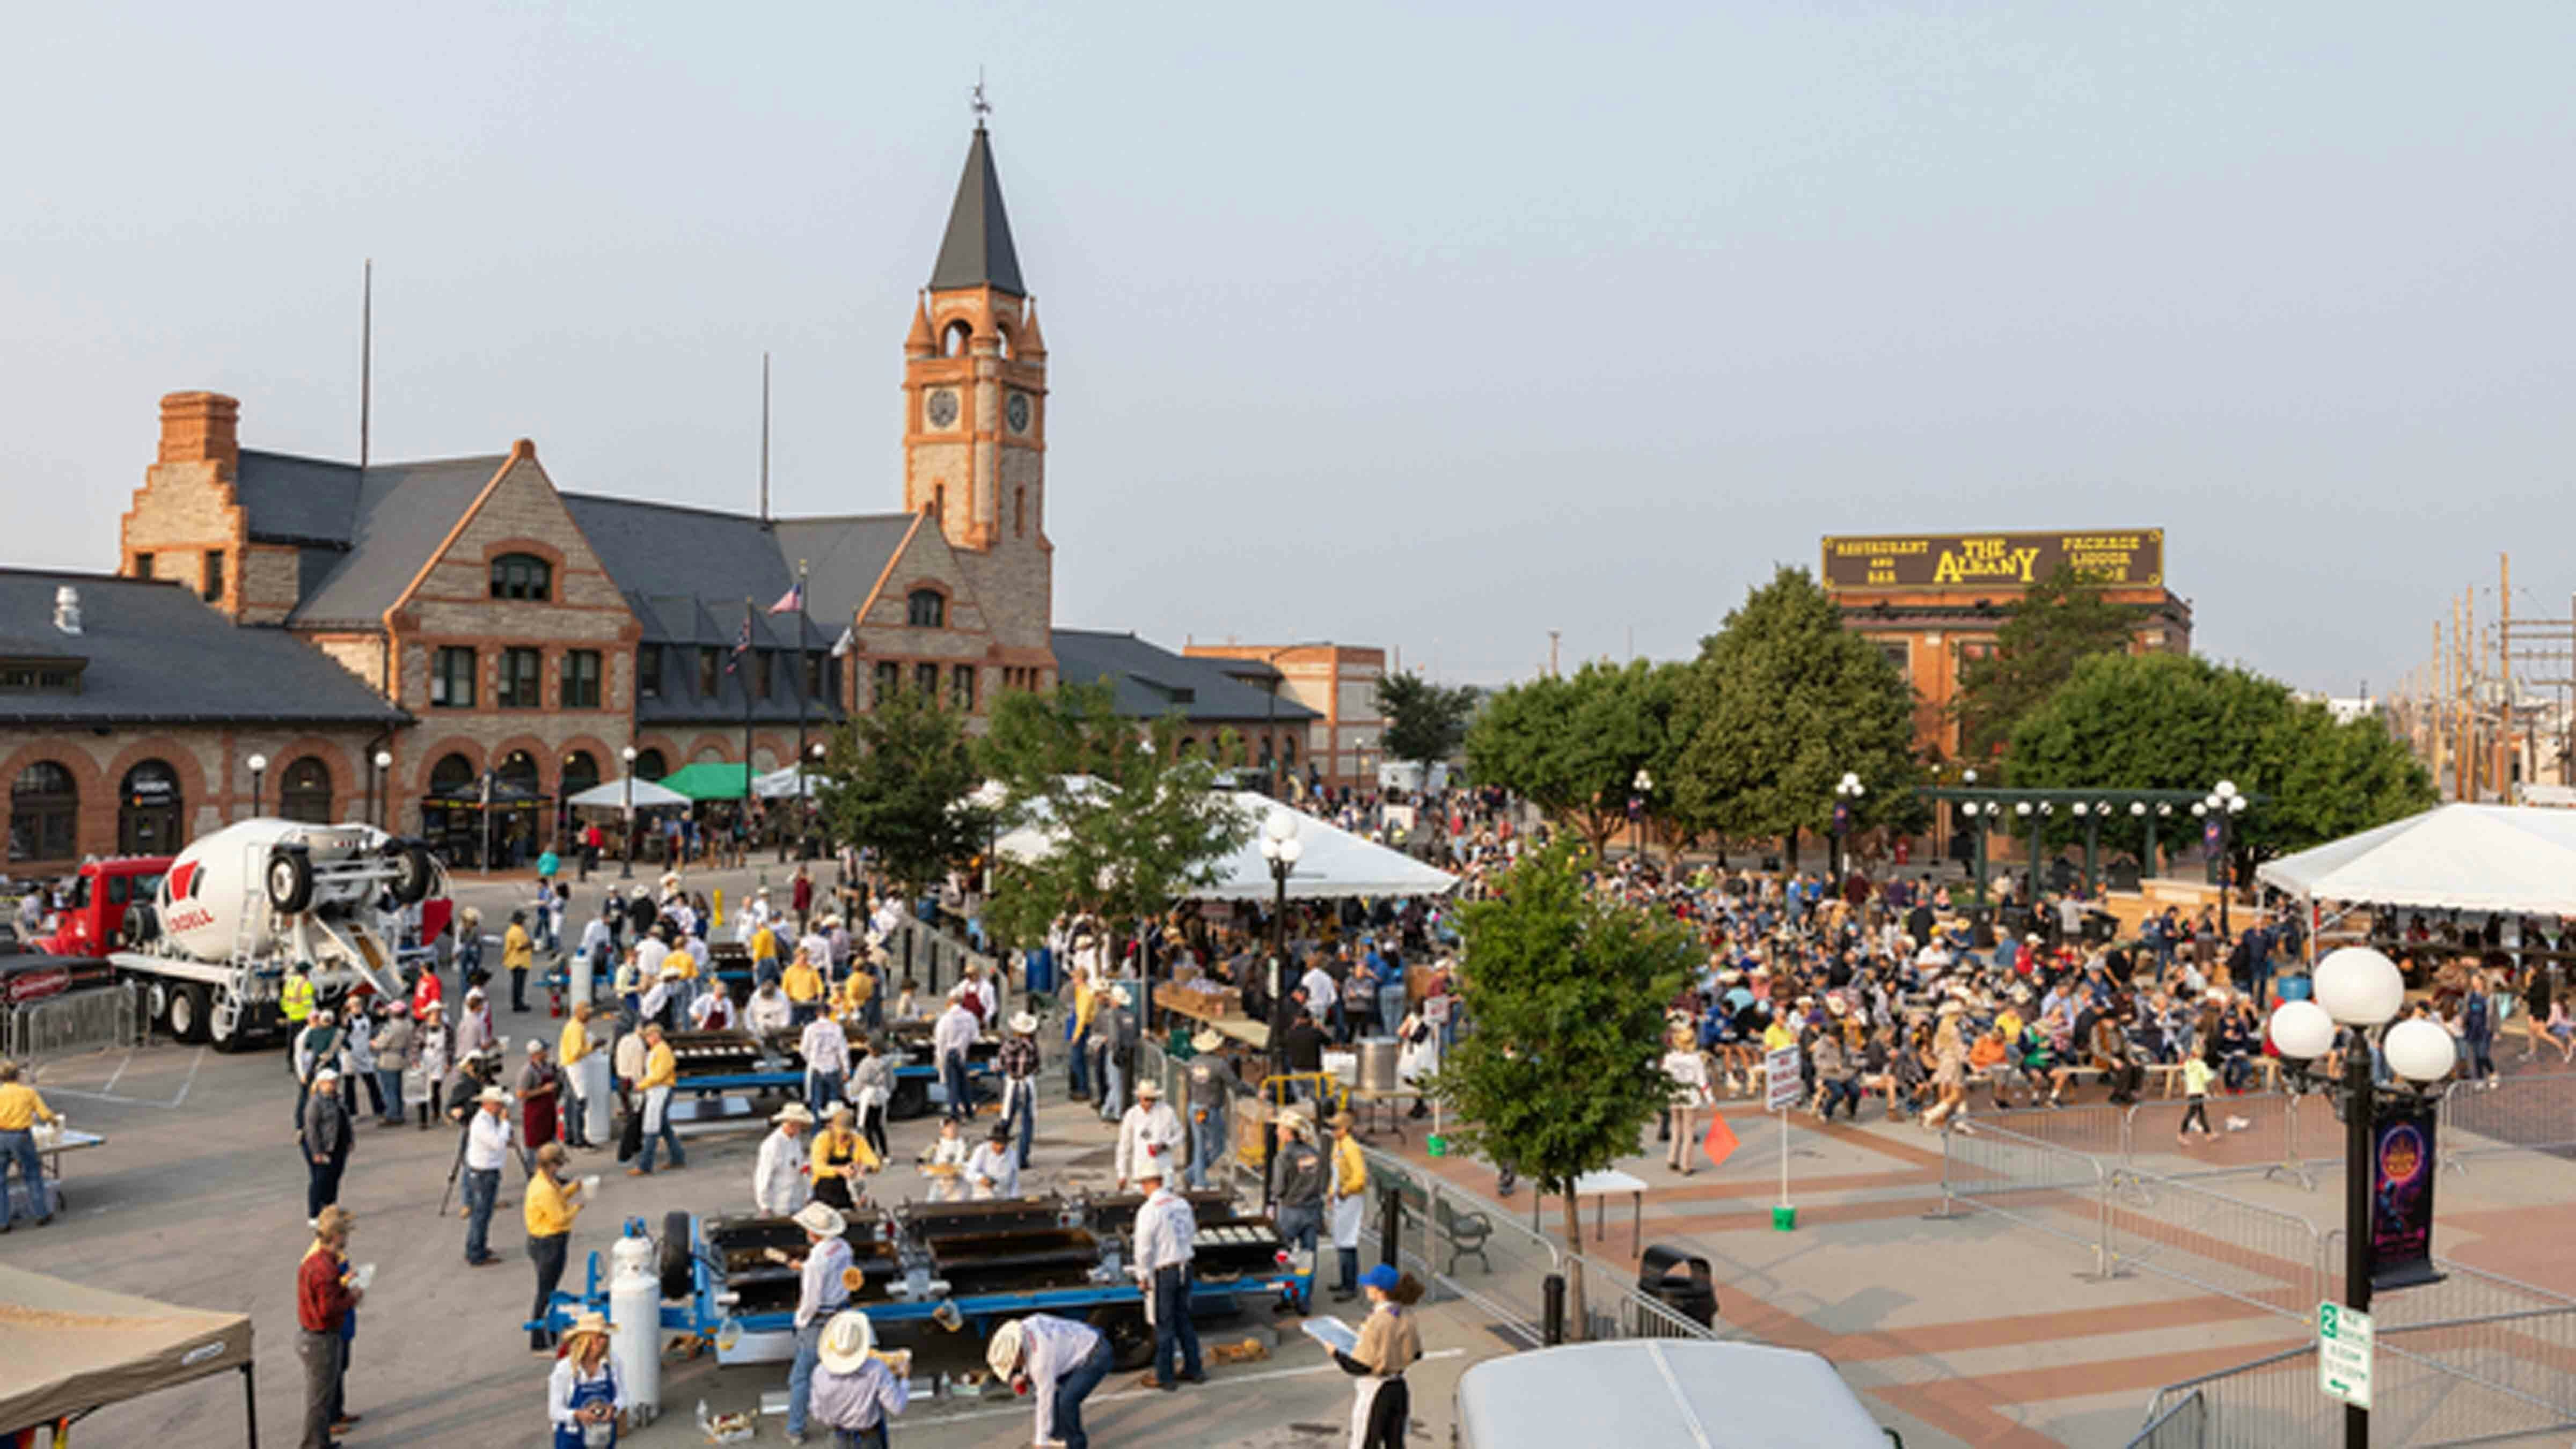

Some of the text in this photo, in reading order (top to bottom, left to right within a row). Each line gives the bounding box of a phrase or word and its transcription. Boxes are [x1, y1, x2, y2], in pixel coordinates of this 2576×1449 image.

[1837, 540, 1929, 555] RESTAURANT
[1962, 539, 2006, 558] THE
[2062, 537, 2140, 551] PACKAGE
[1871, 558, 1895, 567] AND
[1934, 547, 2040, 582] ALBANY
[2070, 552, 2132, 566] LIQUOR
[1868, 570, 1896, 583] BAR
